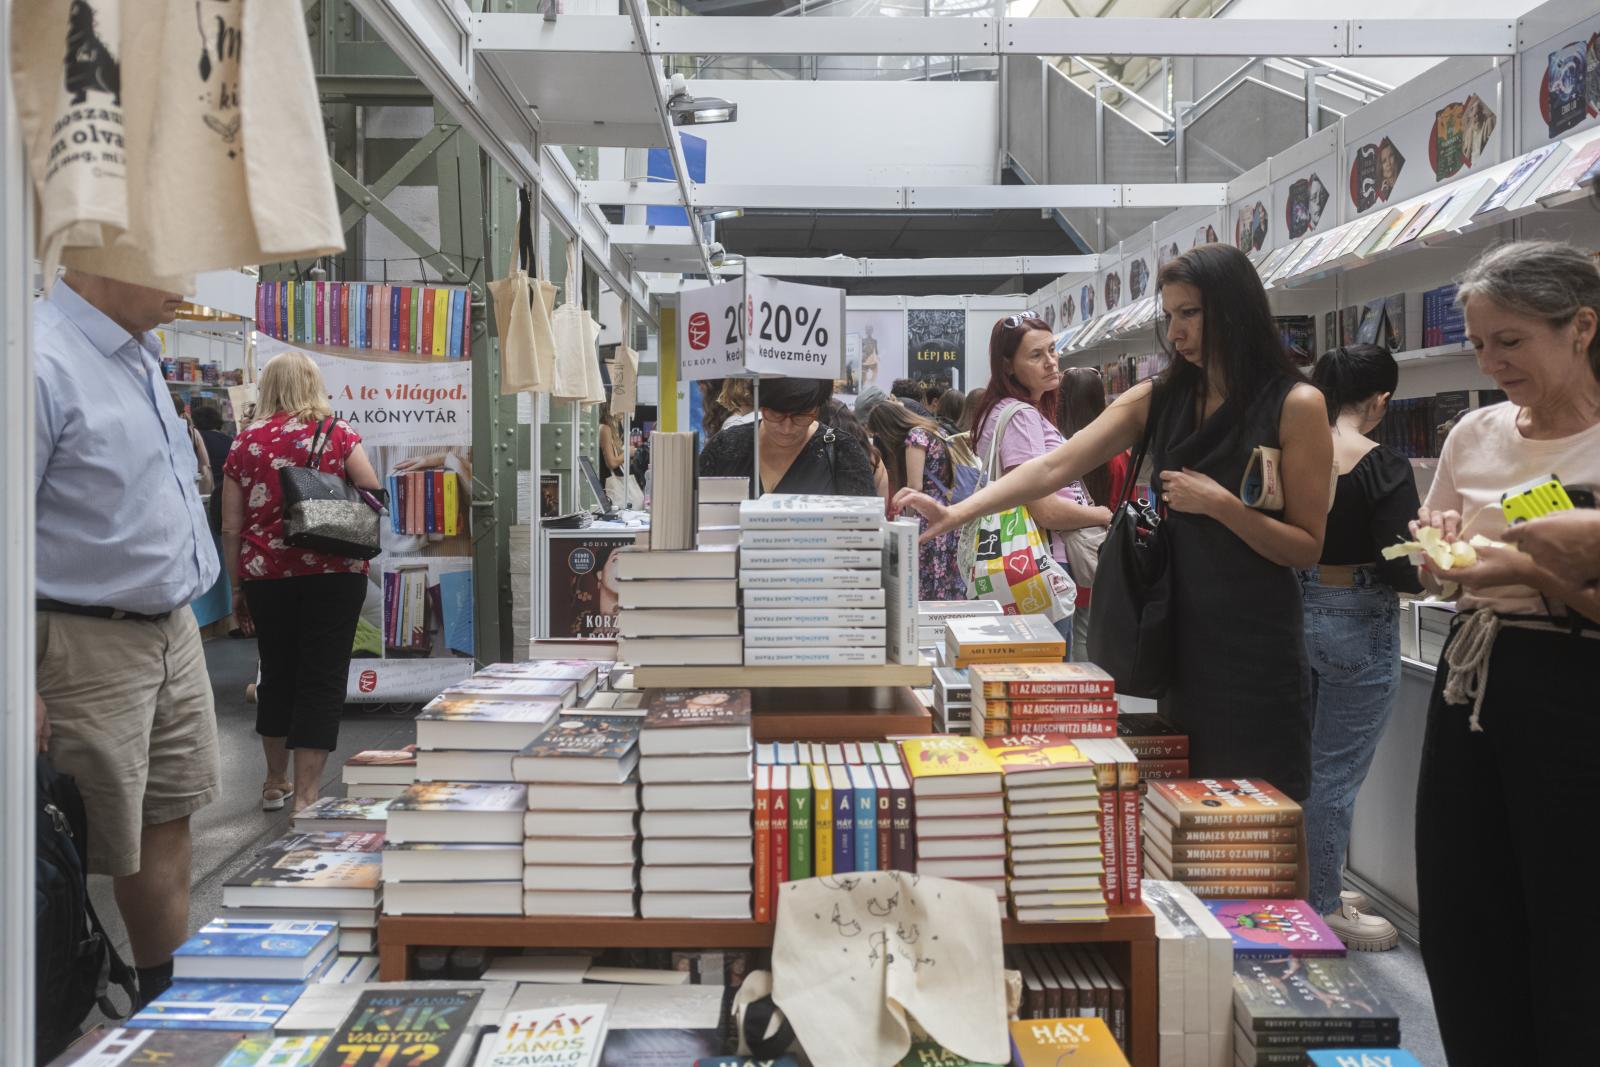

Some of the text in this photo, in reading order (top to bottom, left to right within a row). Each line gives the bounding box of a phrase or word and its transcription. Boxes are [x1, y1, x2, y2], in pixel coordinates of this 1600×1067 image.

[759, 301, 829, 347] 20%
[759, 345, 828, 365] kedvezmény
[917, 349, 957, 362] LÉPJ BE
[682, 357, 717, 368] EURÓPA
[338, 383, 468, 404] A te világod.
[348, 411, 360, 423] A
[364, 407, 457, 423] KÖNYVTÁR
[1019, 681, 1100, 694] AZ AUSCHWITZI BÁBA
[1022, 702, 1104, 714] AZ AUSCHWITZI BÁBA
[1021, 722, 1103, 734] AZ AUSCHWITZI BÁBA
[1194, 814, 1276, 826] HIÁNYZÓ SZÍVÜNK
[1186, 832, 1269, 843] HIÁNYZÓ SZÍVÜNK
[1103, 802, 1118, 890] AZ AUSCHWITZI BÁBA
[1124, 802, 1139, 889] AZ AUSCHWITZI BÁBA
[1186, 850, 1270, 861] HIÁNYZÓ SZÍVÜNK
[1188, 868, 1271, 878] HIÁNYZÓ SZÍVÜNK
[1227, 886, 1269, 896] HIÁNYZÓ
[351, 1006, 460, 1031] KIK
[506, 1013, 593, 1040] HÁY
[1031, 1022, 1086, 1039] HÁY
